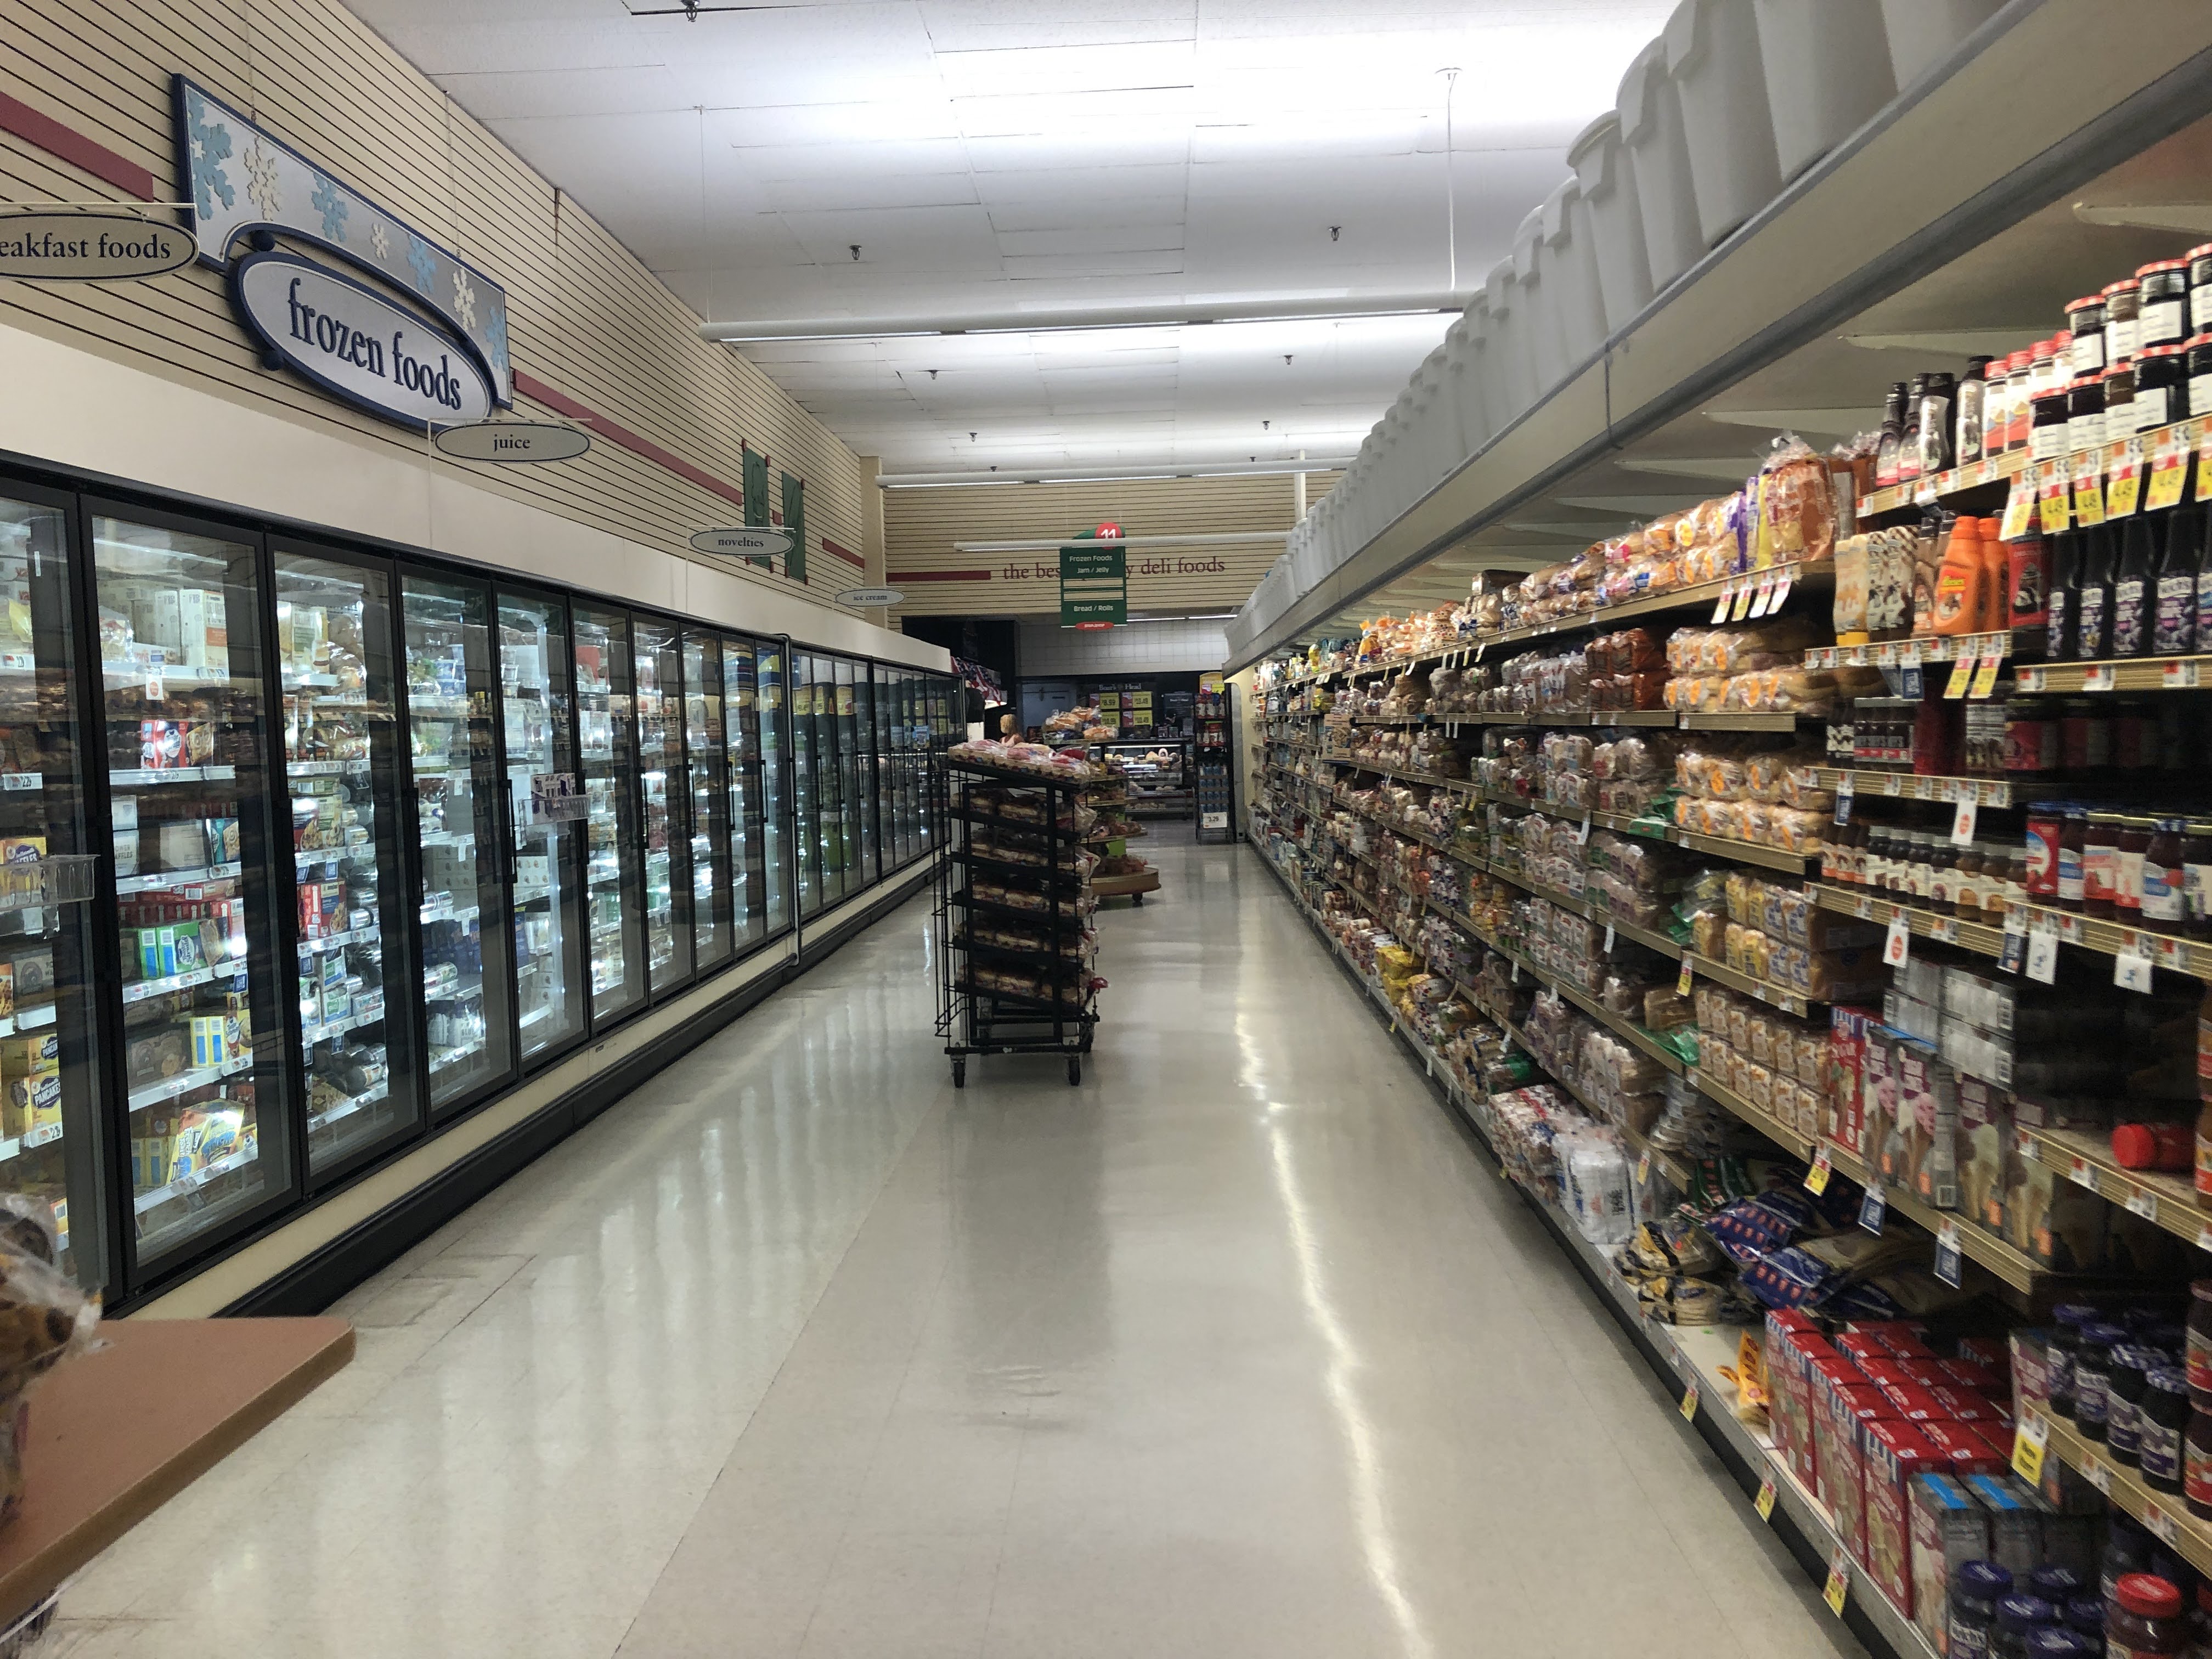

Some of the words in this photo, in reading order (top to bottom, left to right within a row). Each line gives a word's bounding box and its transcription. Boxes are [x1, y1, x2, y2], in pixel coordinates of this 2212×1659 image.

[0, 232, 89, 258] eakfast
[98, 233, 171, 258] foods
[287, 277, 386, 378] frozen
[392, 331, 462, 410] foods
[493, 433, 531, 452] juice
[718, 537, 764, 548] novelties
[1101, 528, 1116, 539] 11
[1003, 563, 1029, 579] the
[1036, 562, 1061, 579] bes
[1141, 558, 1171, 575] deli
[1177, 556, 1225, 573] foods
[115, 851, 133, 860] AFFLES
[35, 1082, 60, 1105] PANCAKE
